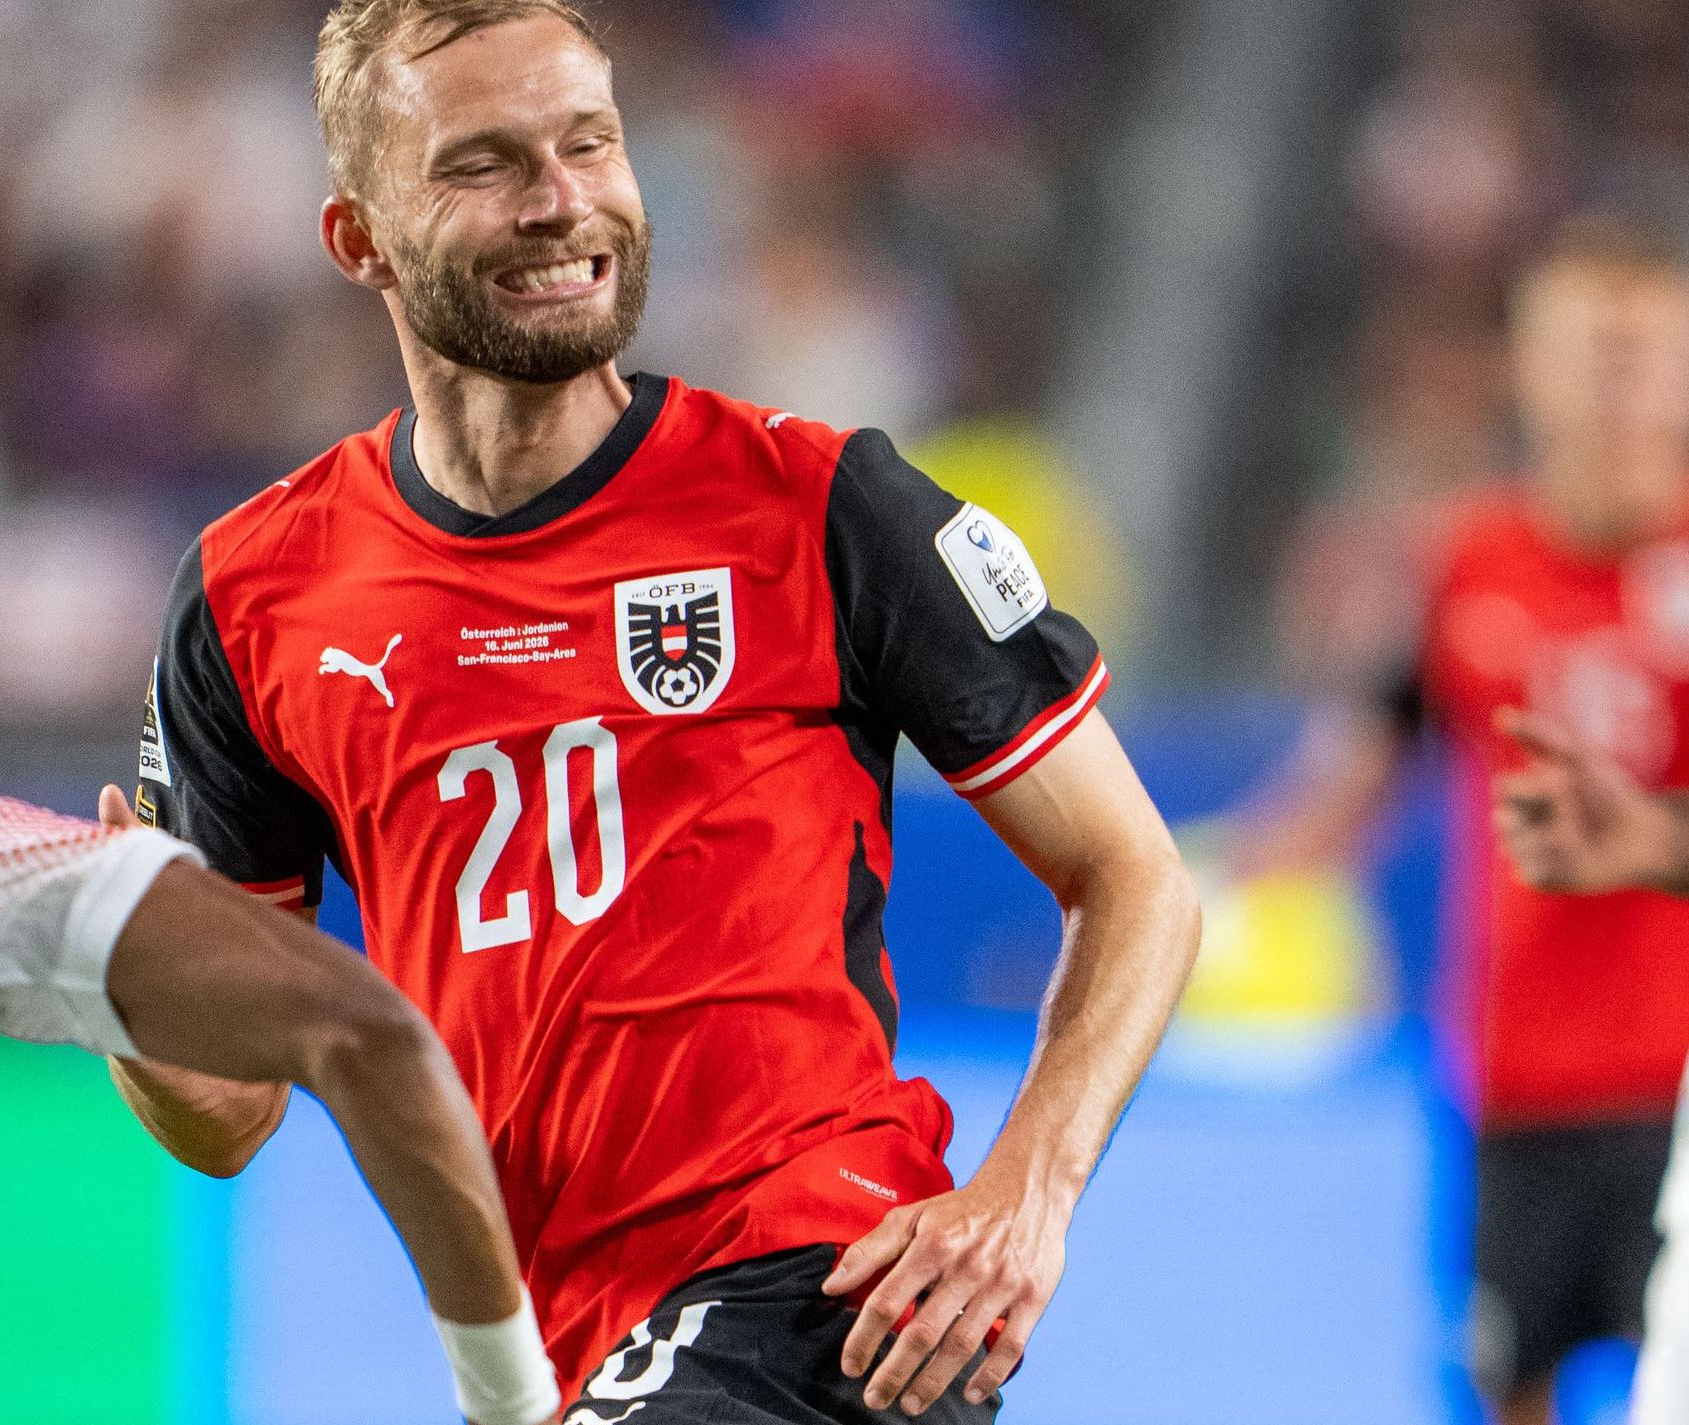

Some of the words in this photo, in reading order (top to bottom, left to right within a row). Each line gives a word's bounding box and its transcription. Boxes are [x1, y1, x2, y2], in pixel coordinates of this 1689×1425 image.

[649, 583, 695, 598] ÖFB
[996, 562, 1030, 602] PEACE
[461, 626, 516, 640] Österreich
[522, 621, 569, 636] Jordanien
[485, 640, 500, 652] 16.
[501, 639, 523, 652] Juni
[525, 636, 549, 649] 2026
[457, 648, 576, 666] San-Francisco-Bay-Area
[141, 755, 162, 772] 026
[438, 716, 625, 953] 20
[838, 1167, 898, 1201] ULTRAWEAVE
